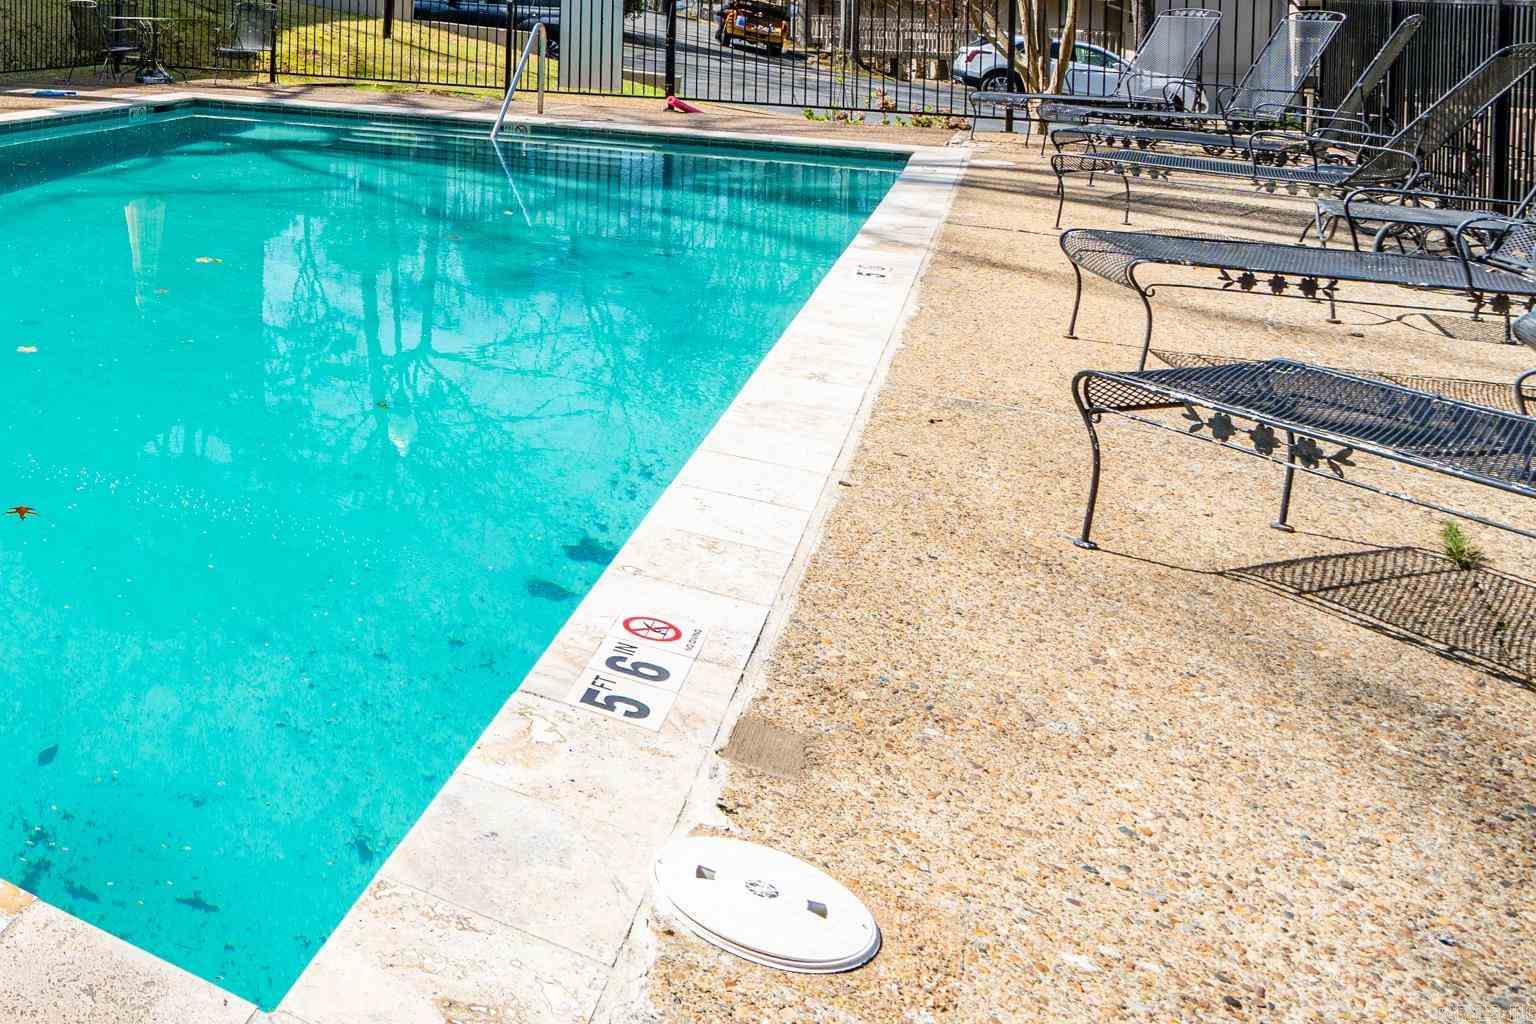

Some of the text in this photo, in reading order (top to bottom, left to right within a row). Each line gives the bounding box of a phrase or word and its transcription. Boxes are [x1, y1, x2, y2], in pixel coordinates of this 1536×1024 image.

[579, 641, 671, 719] 5 FT 6 IN
